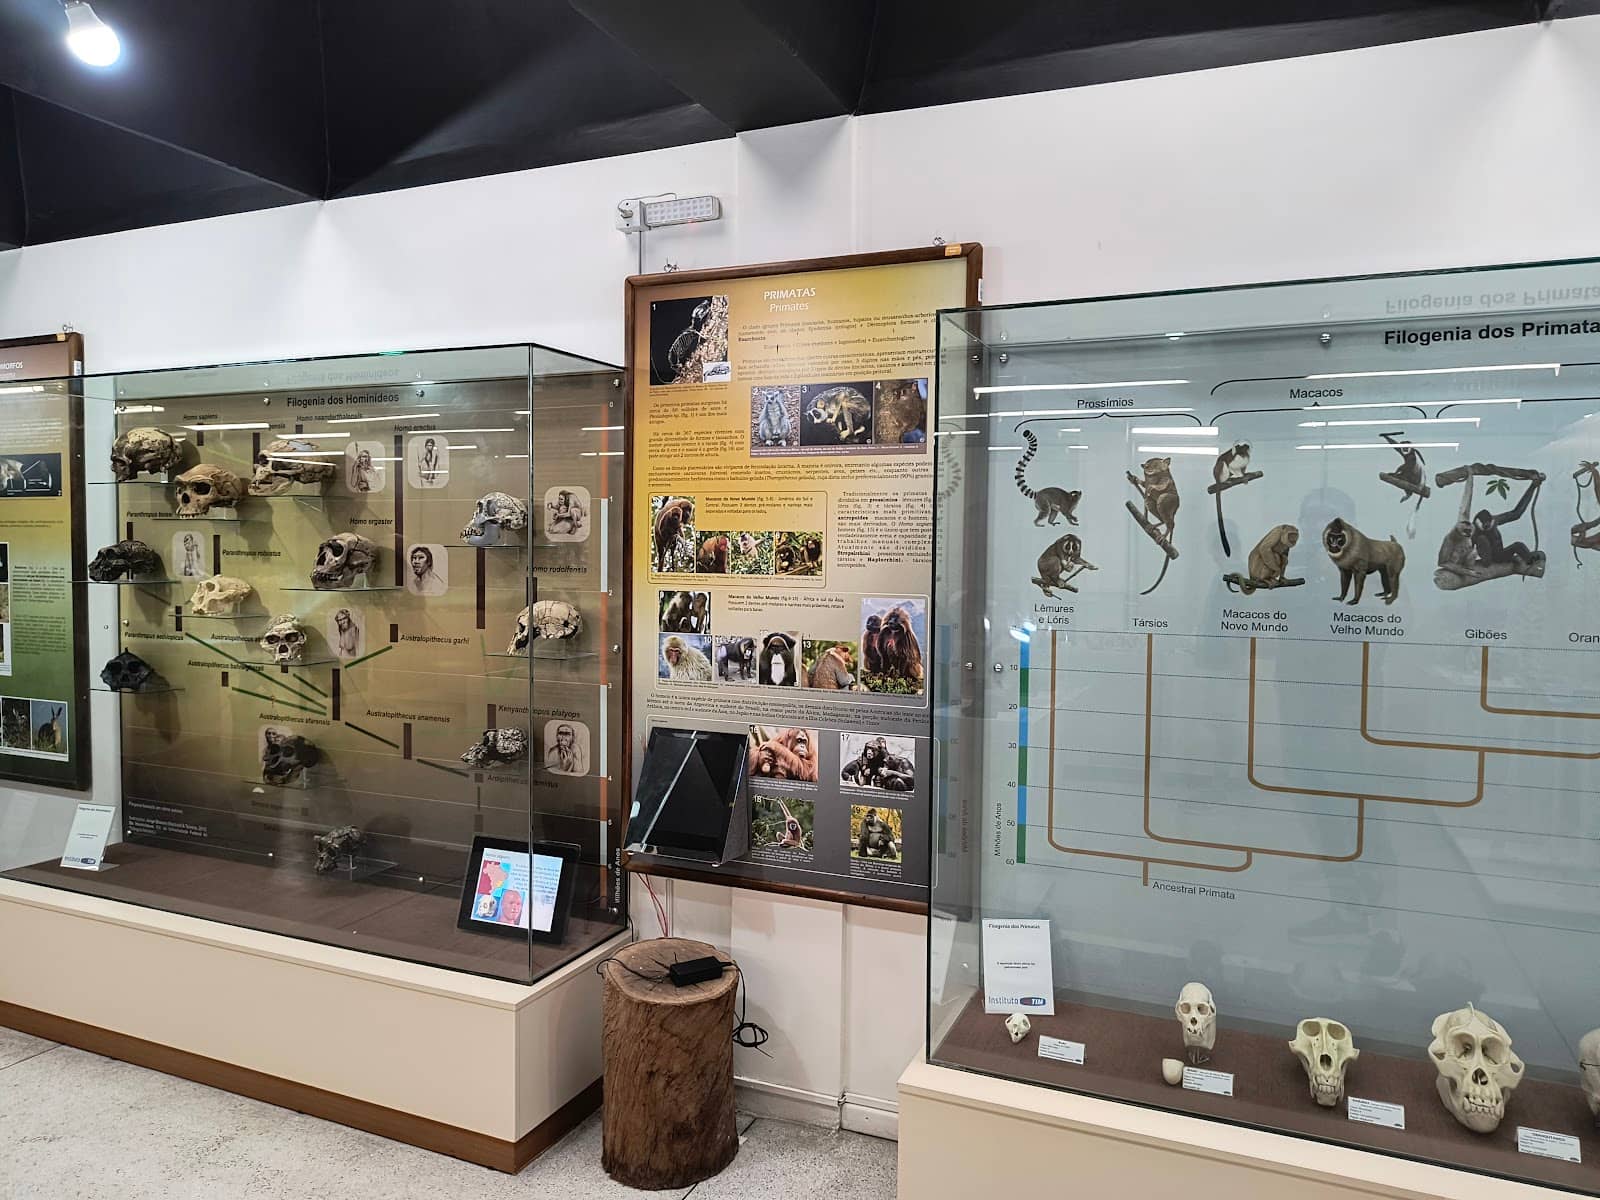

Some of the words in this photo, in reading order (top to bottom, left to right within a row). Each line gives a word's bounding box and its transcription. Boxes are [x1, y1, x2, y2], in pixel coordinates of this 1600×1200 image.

[764, 287, 816, 300] PRIMATAS
[769, 302, 809, 312] Primates
[1384, 327, 1472, 346] Filogenia
[1478, 325, 1515, 340] dos
[1522, 319, 1600, 337] Primata
[802, 385, 807, 393] 3
[1290, 387, 1343, 399] Macacos
[287, 396, 326, 408] Filogenia
[328, 395, 343, 405] dos
[346, 392, 400, 404] Hominídeos
[1077, 397, 1134, 409] Prossímios
[1034, 603, 1075, 614] Lêmures
[1222, 608, 1271, 620] Macacos
[1273, 609, 1288, 621] do
[1038, 617, 1045, 625] e
[1047, 614, 1070, 625] Lóris
[1133, 617, 1169, 629] Társios
[1333, 611, 1385, 623] Macacos
[1387, 612, 1402, 624] do
[1220, 620, 1249, 632] Novo
[1251, 621, 1289, 633] Mundo
[1330, 624, 1362, 635] Velho
[1365, 625, 1405, 637] Mundo
[400, 633, 453, 644] Australopithecus
[453, 636, 470, 646] garhi
[1464, 628, 1508, 640] Gibões
[1568, 632, 1600, 644] Oran
[802, 640, 811, 649] 13
[366, 709, 417, 721] Australopithecus
[417, 714, 450, 724] anamensis
[498, 704, 550, 717] Kenyanthopus
[551, 709, 580, 719] platyops
[1006, 819, 1016, 827] 50
[1005, 858, 1015, 866] 60
[1153, 881, 1197, 895] Ancestral
[1198, 886, 1236, 900] Primata
[988, 995, 1019, 1006] Instituto
[1031, 998, 1044, 1006] TIM
